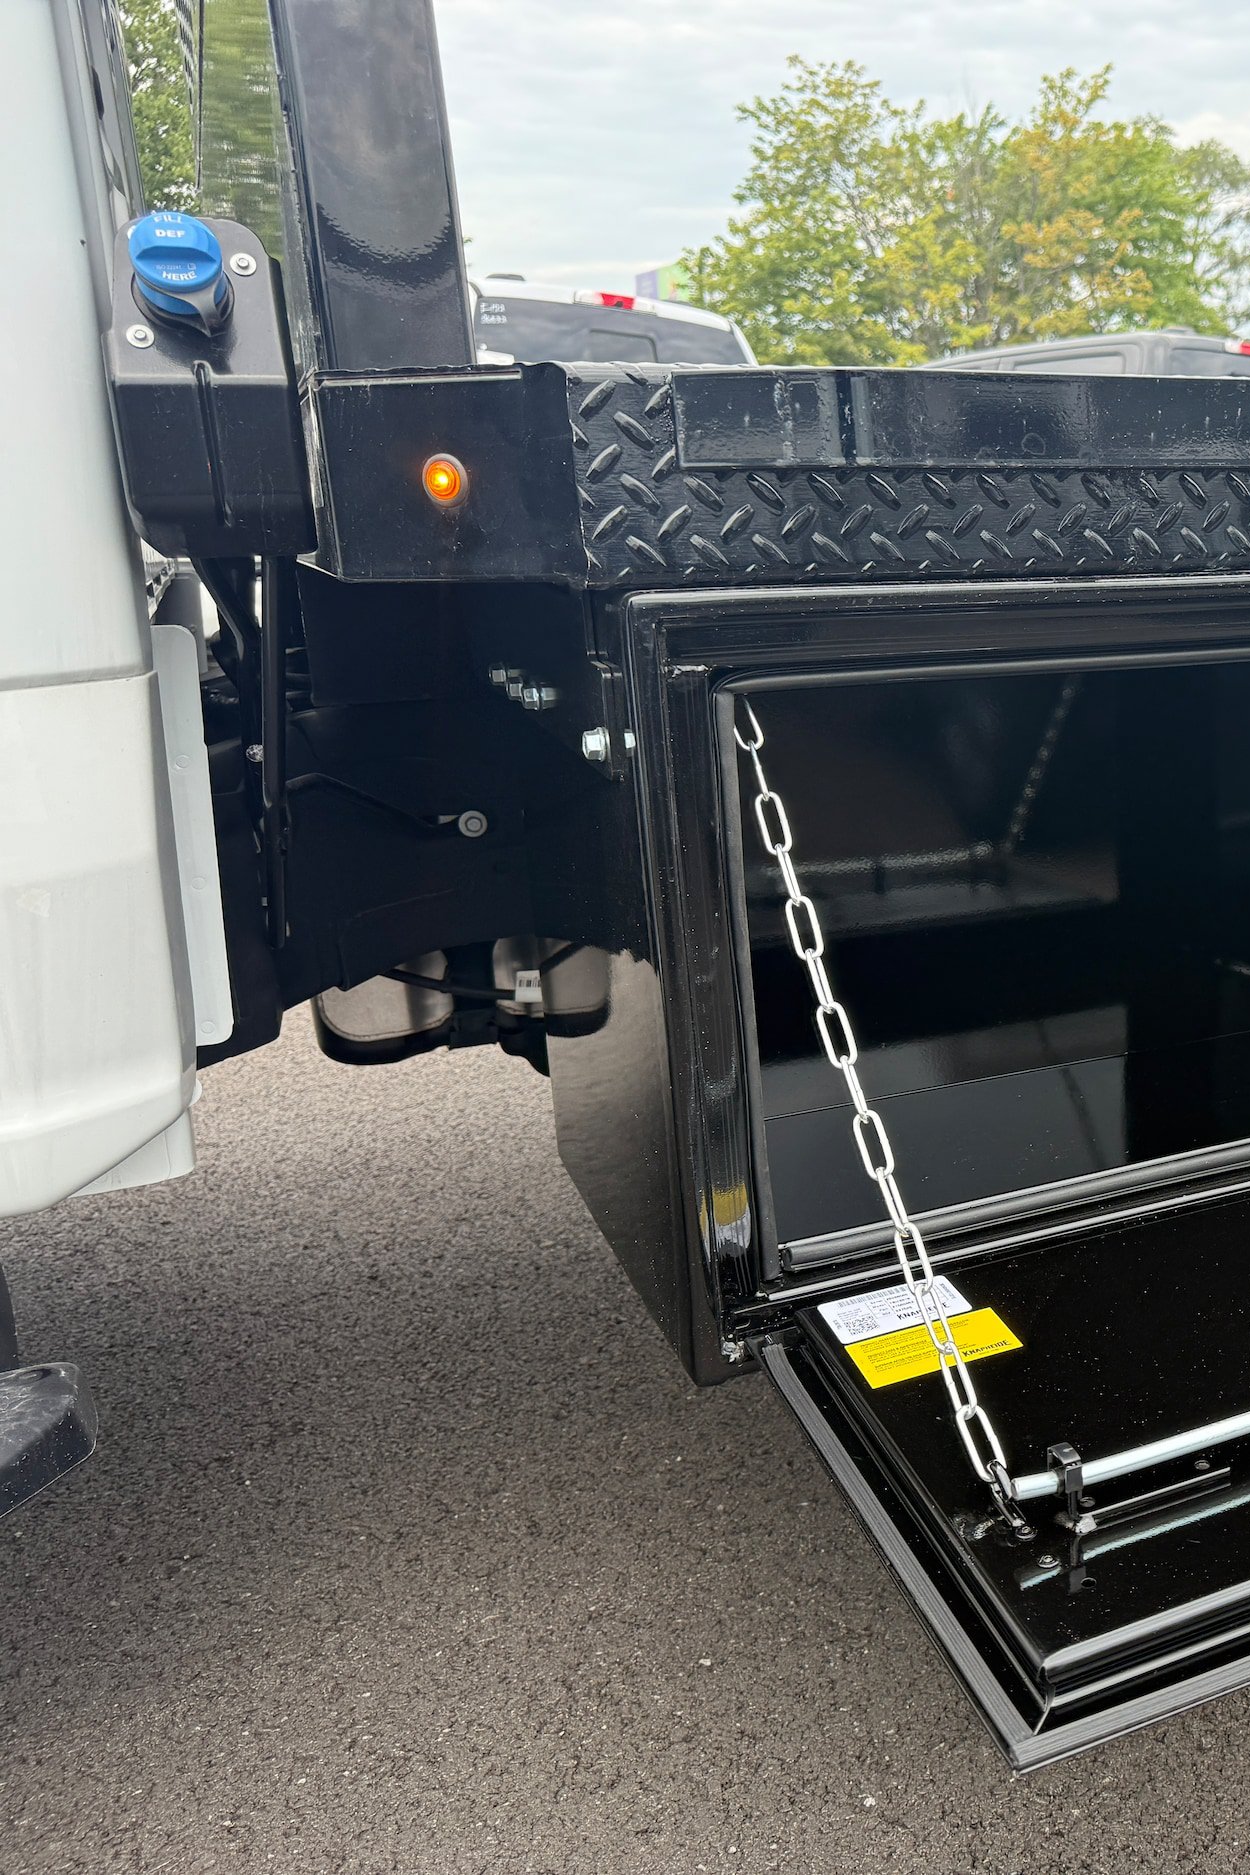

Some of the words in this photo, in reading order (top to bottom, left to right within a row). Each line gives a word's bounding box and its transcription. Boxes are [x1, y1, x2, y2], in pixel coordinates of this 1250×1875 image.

[154, 215, 182, 224] FILL
[155, 229, 186, 238] DEF
[163, 271, 198, 281] HERE
